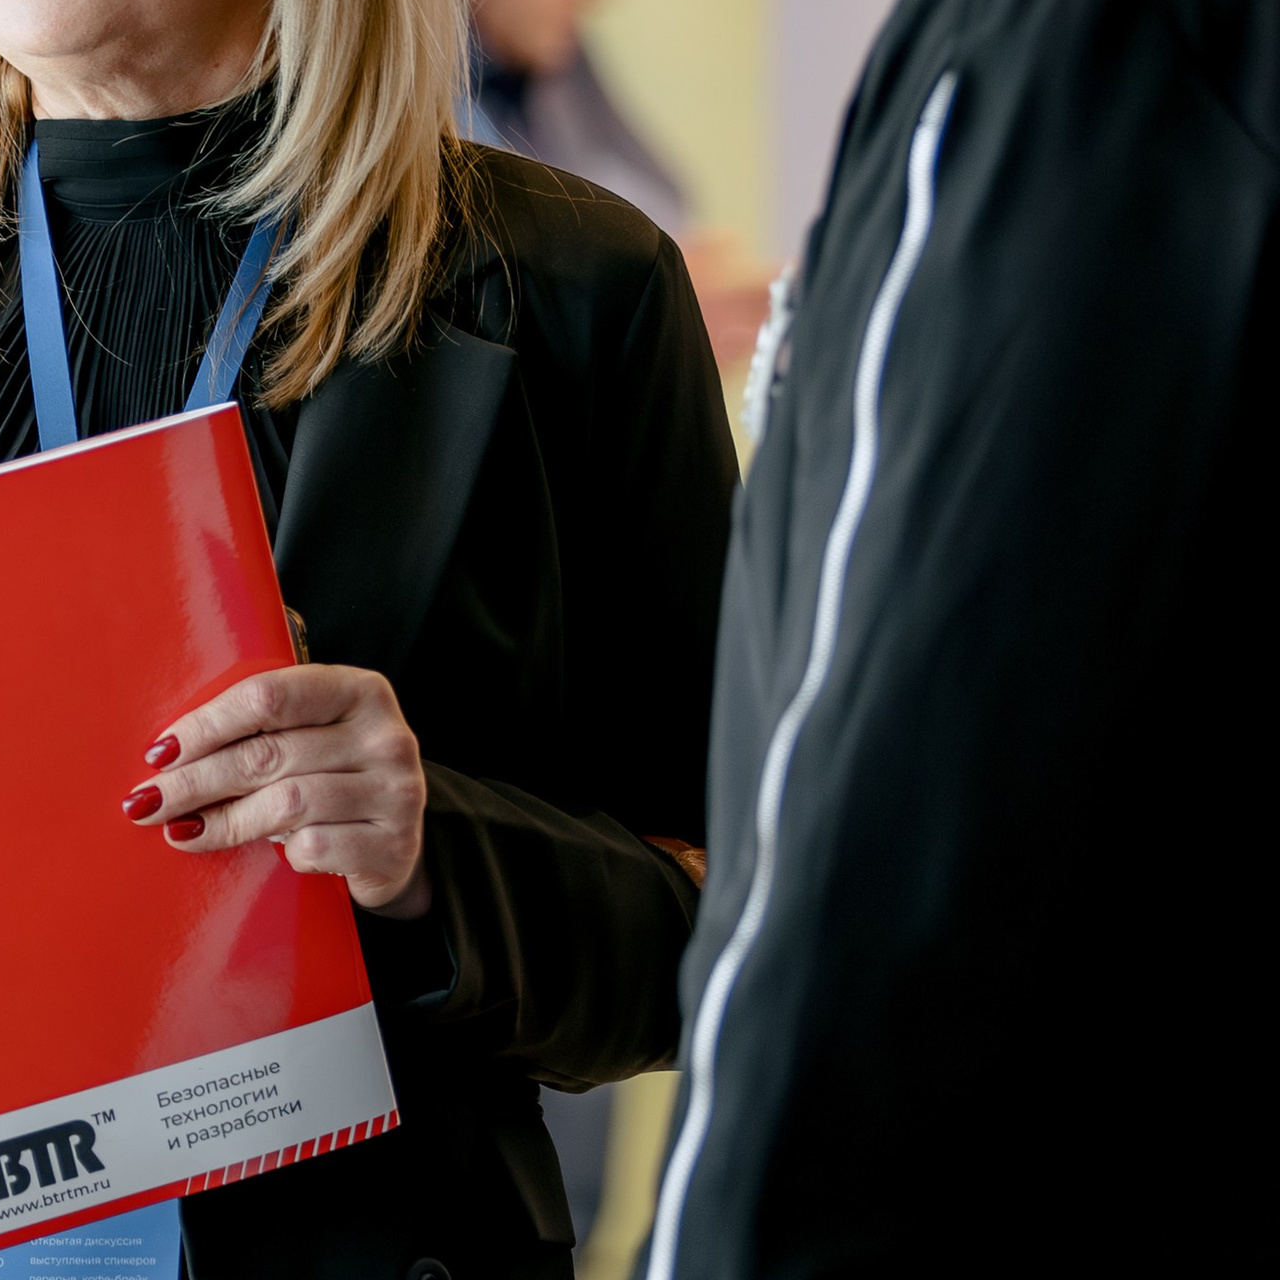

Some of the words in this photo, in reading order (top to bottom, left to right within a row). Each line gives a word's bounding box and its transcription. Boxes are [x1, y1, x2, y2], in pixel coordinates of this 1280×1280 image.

[156, 1061, 281, 1108] Безопасные
[160, 1084, 278, 1129] технологии
[167, 1136, 181, 1150] и
[186, 1099, 303, 1148] разработки
[30, 1237, 82, 1246] открытая
[84, 1237, 142, 1246] дискуссия
[30, 1256, 101, 1266] выступления
[104, 1256, 156, 1266] спикеров
